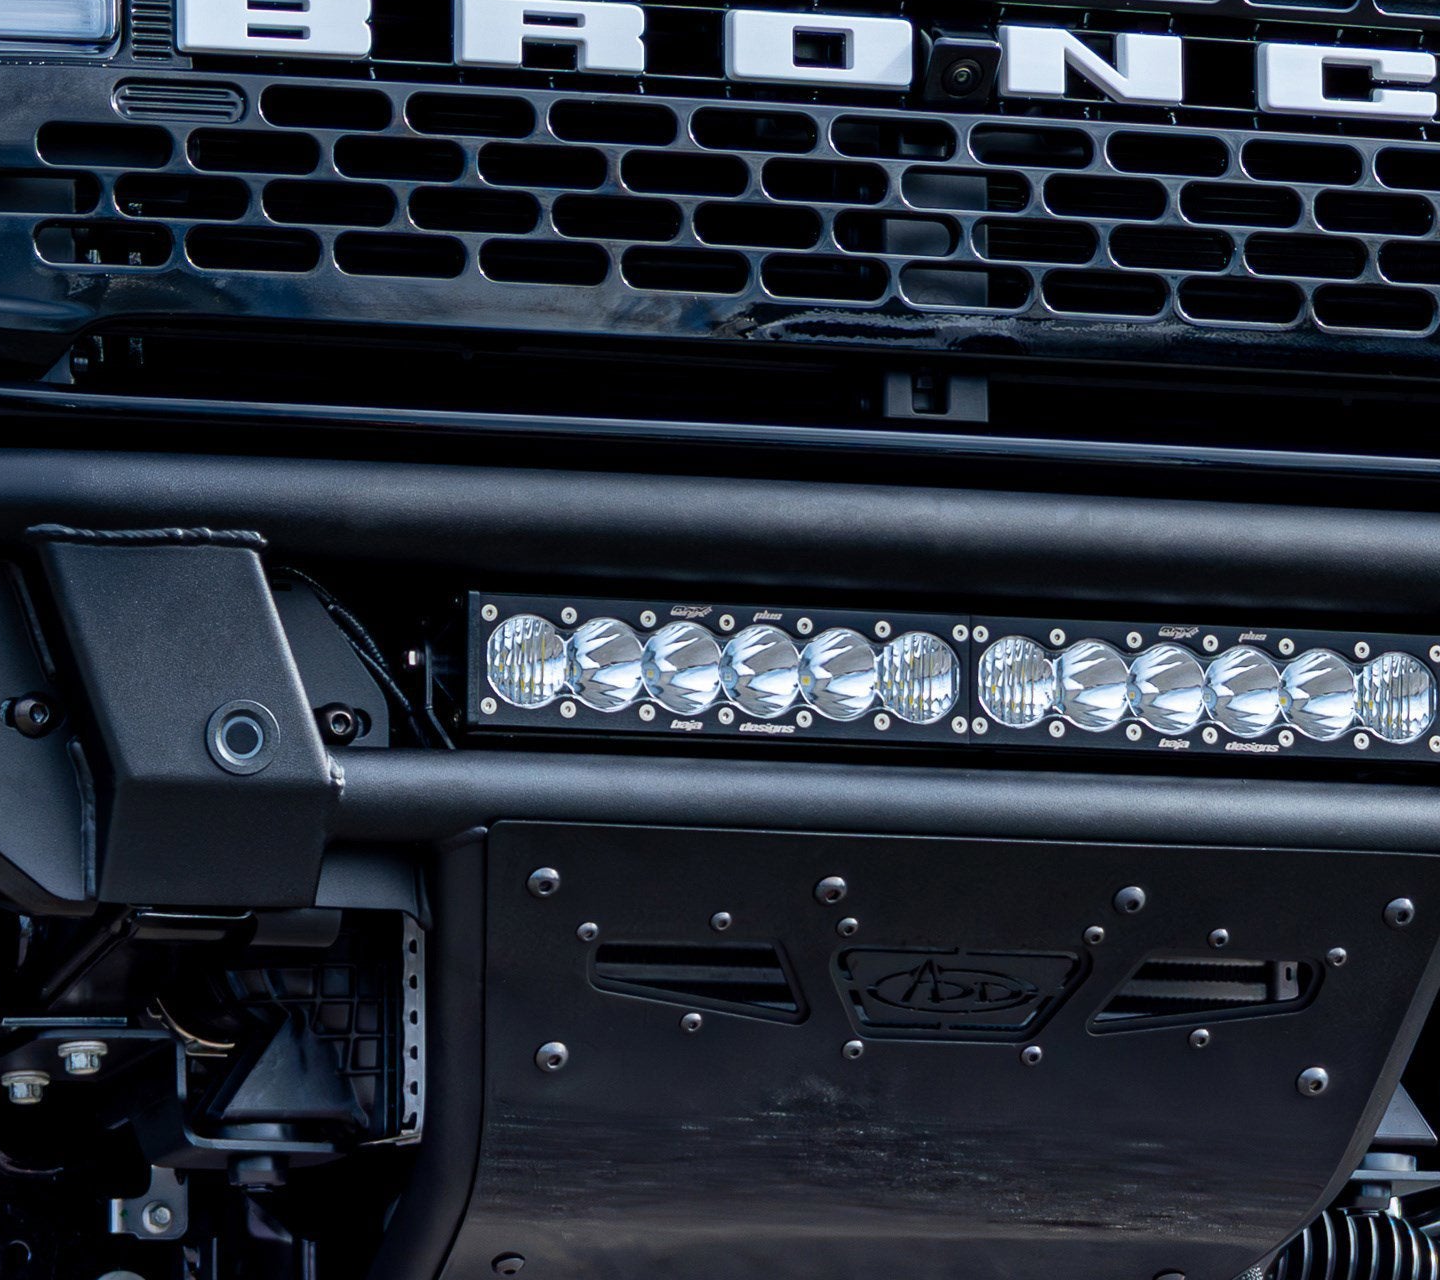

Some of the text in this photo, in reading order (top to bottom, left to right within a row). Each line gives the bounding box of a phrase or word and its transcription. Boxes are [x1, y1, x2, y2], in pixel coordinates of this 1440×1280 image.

[670, 719, 796, 734] baja designs
[1158, 738, 1280, 753] baja designs
